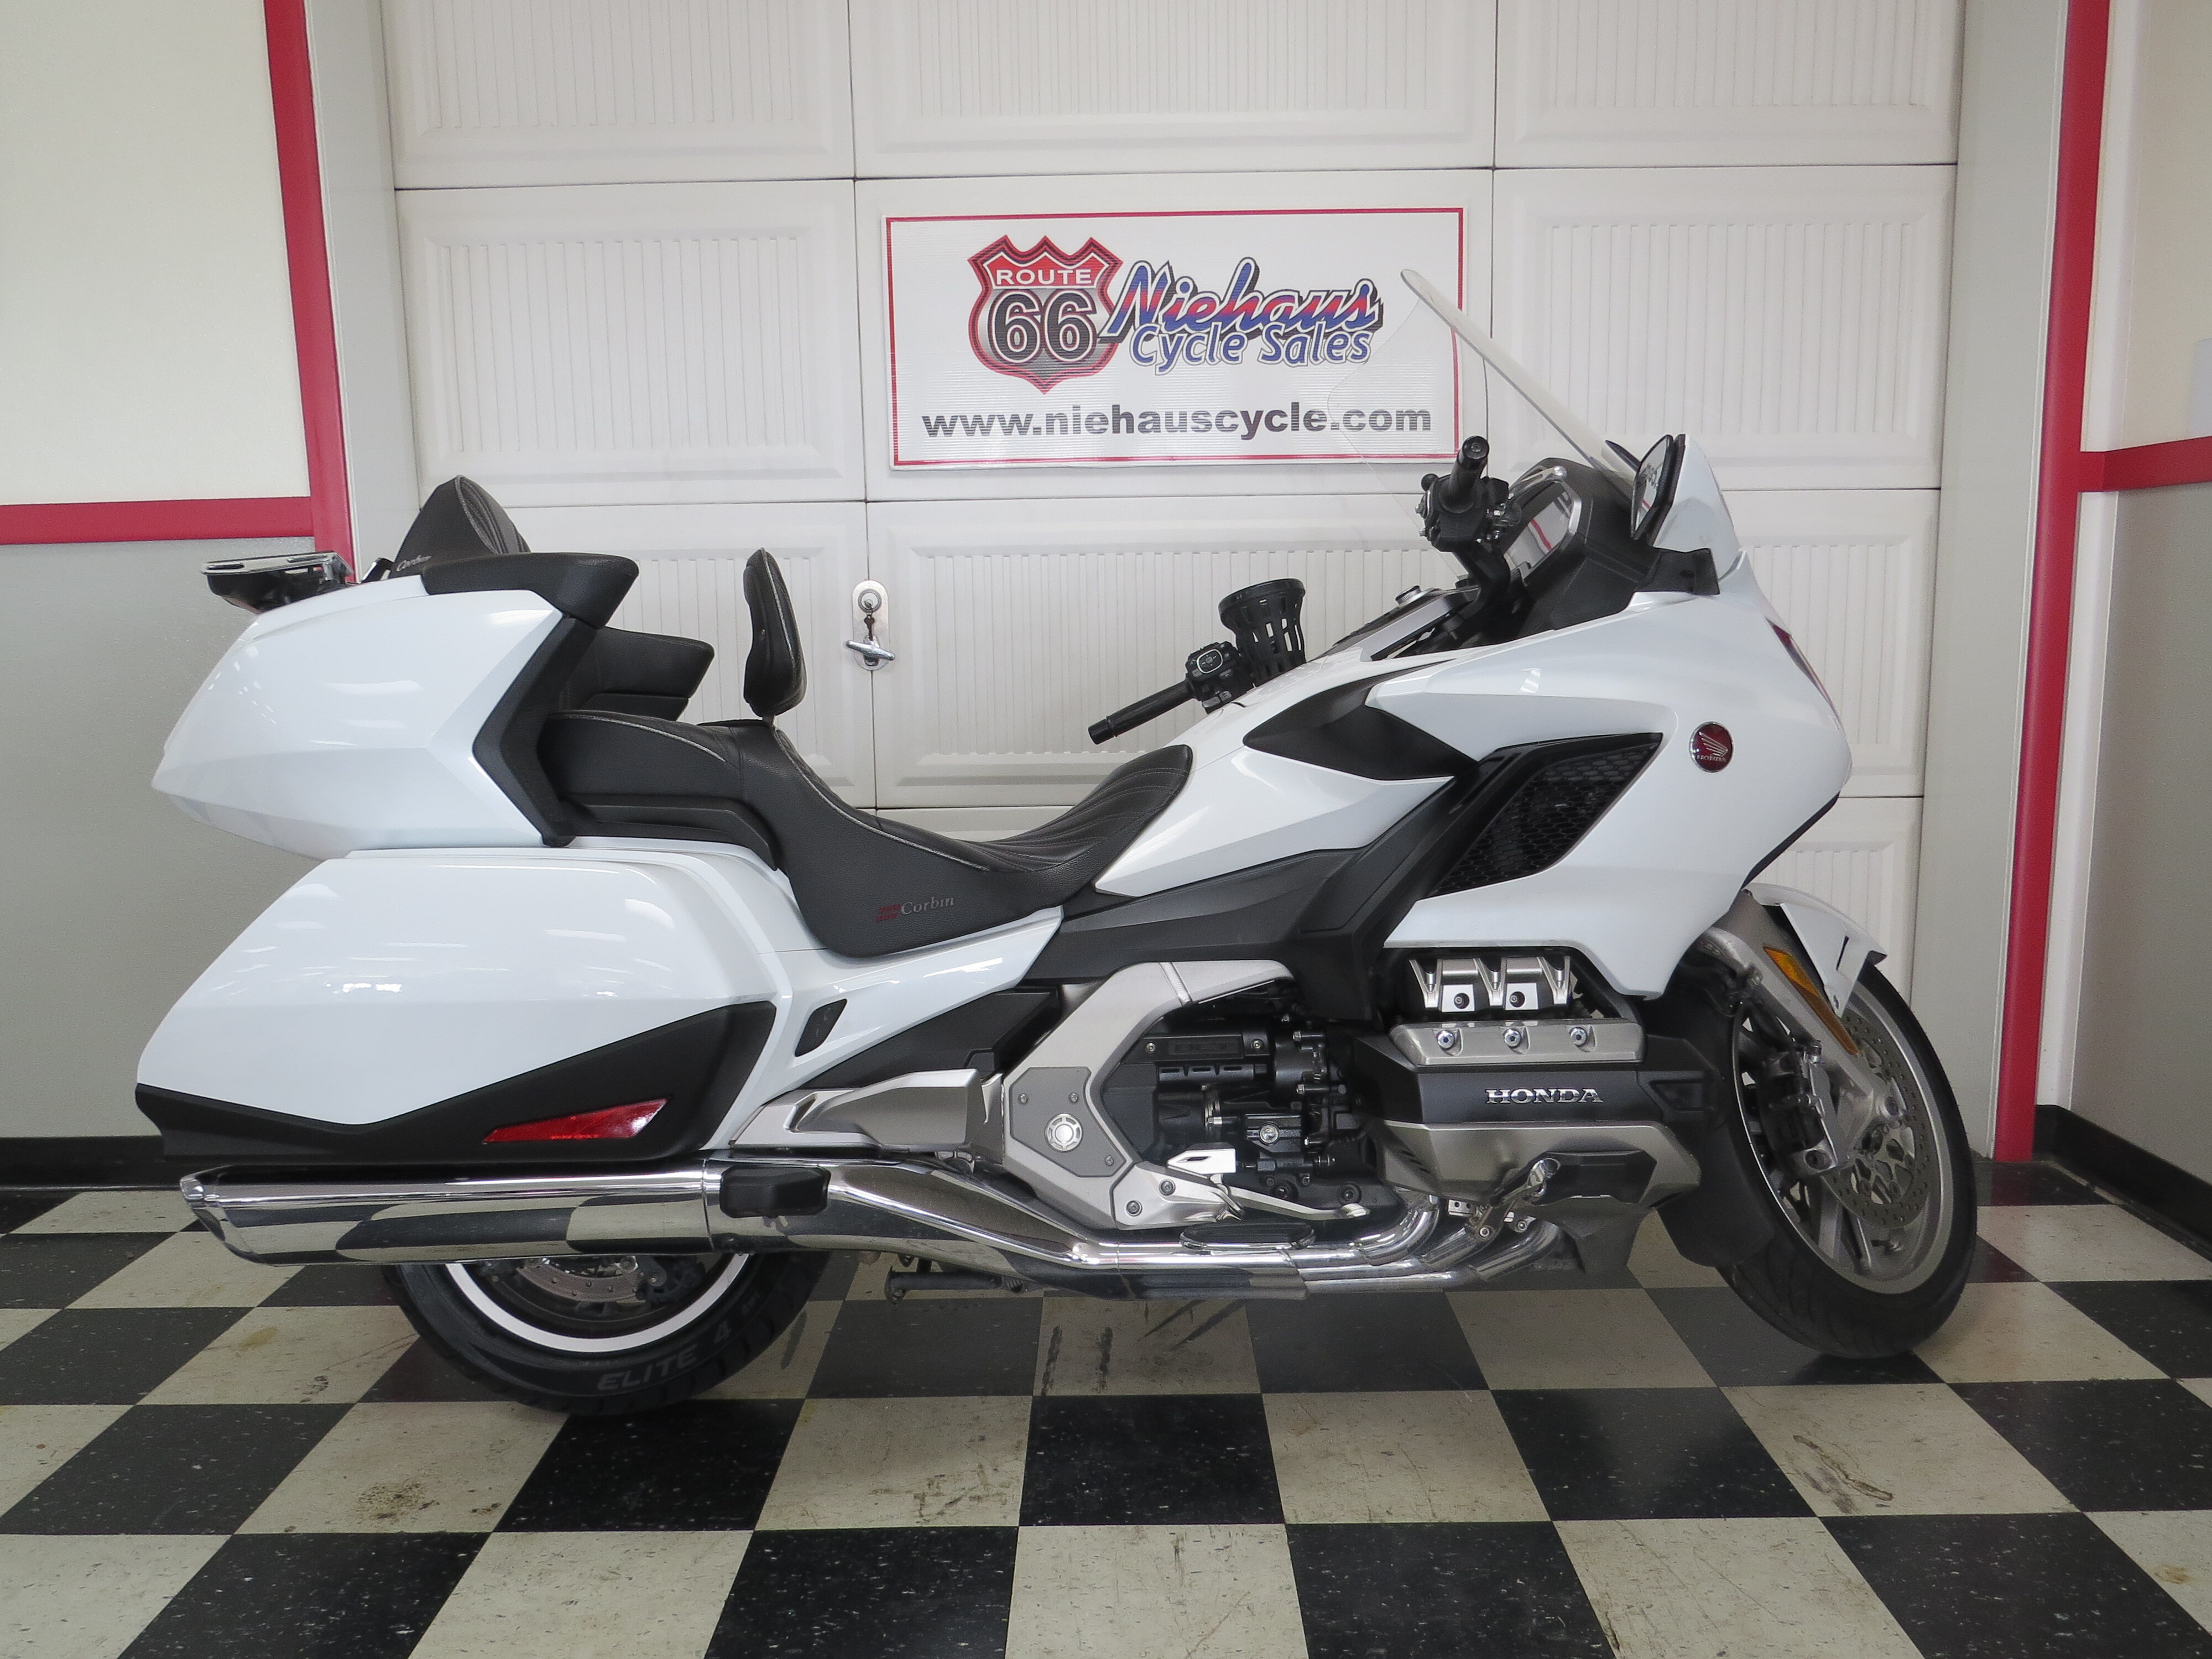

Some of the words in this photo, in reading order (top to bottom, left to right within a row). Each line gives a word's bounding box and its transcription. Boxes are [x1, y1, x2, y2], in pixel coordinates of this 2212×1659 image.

[996, 268, 1092, 285] ROUTE
[1103, 257, 1384, 338] Niehaus
[990, 289, 1098, 363] 66
[1129, 323, 1244, 375] Cycle
[1257, 321, 1374, 368] Sales
[921, 401, 1432, 441] www.niehauscycle.com
[1696, 754, 1727, 763] HONDA
[901, 896, 954, 915] Corbin
[1485, 1088, 1604, 1104] HONDA
[597, 1343, 698, 1391] ELITE
[713, 1321, 733, 1344] 4
